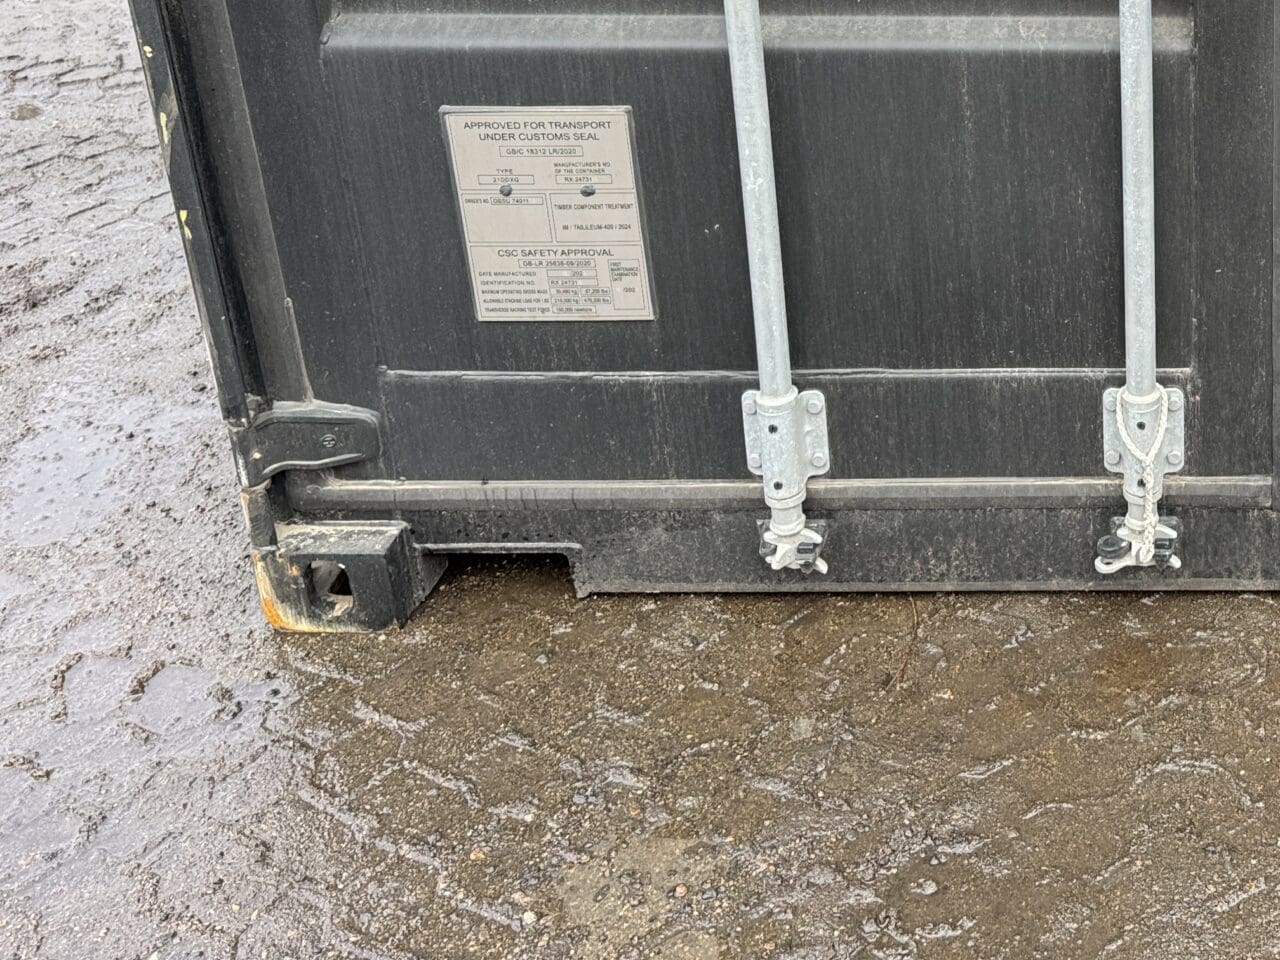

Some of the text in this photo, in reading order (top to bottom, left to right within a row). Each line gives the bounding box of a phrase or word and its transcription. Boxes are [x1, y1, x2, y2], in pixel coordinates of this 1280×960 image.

[464, 121, 612, 130] APPROVED FOR TRANSPORT
[479, 132, 600, 141] UNDER CUSTOMS SEAL
[497, 248, 614, 257] CSC SAFETY APPROVAL
